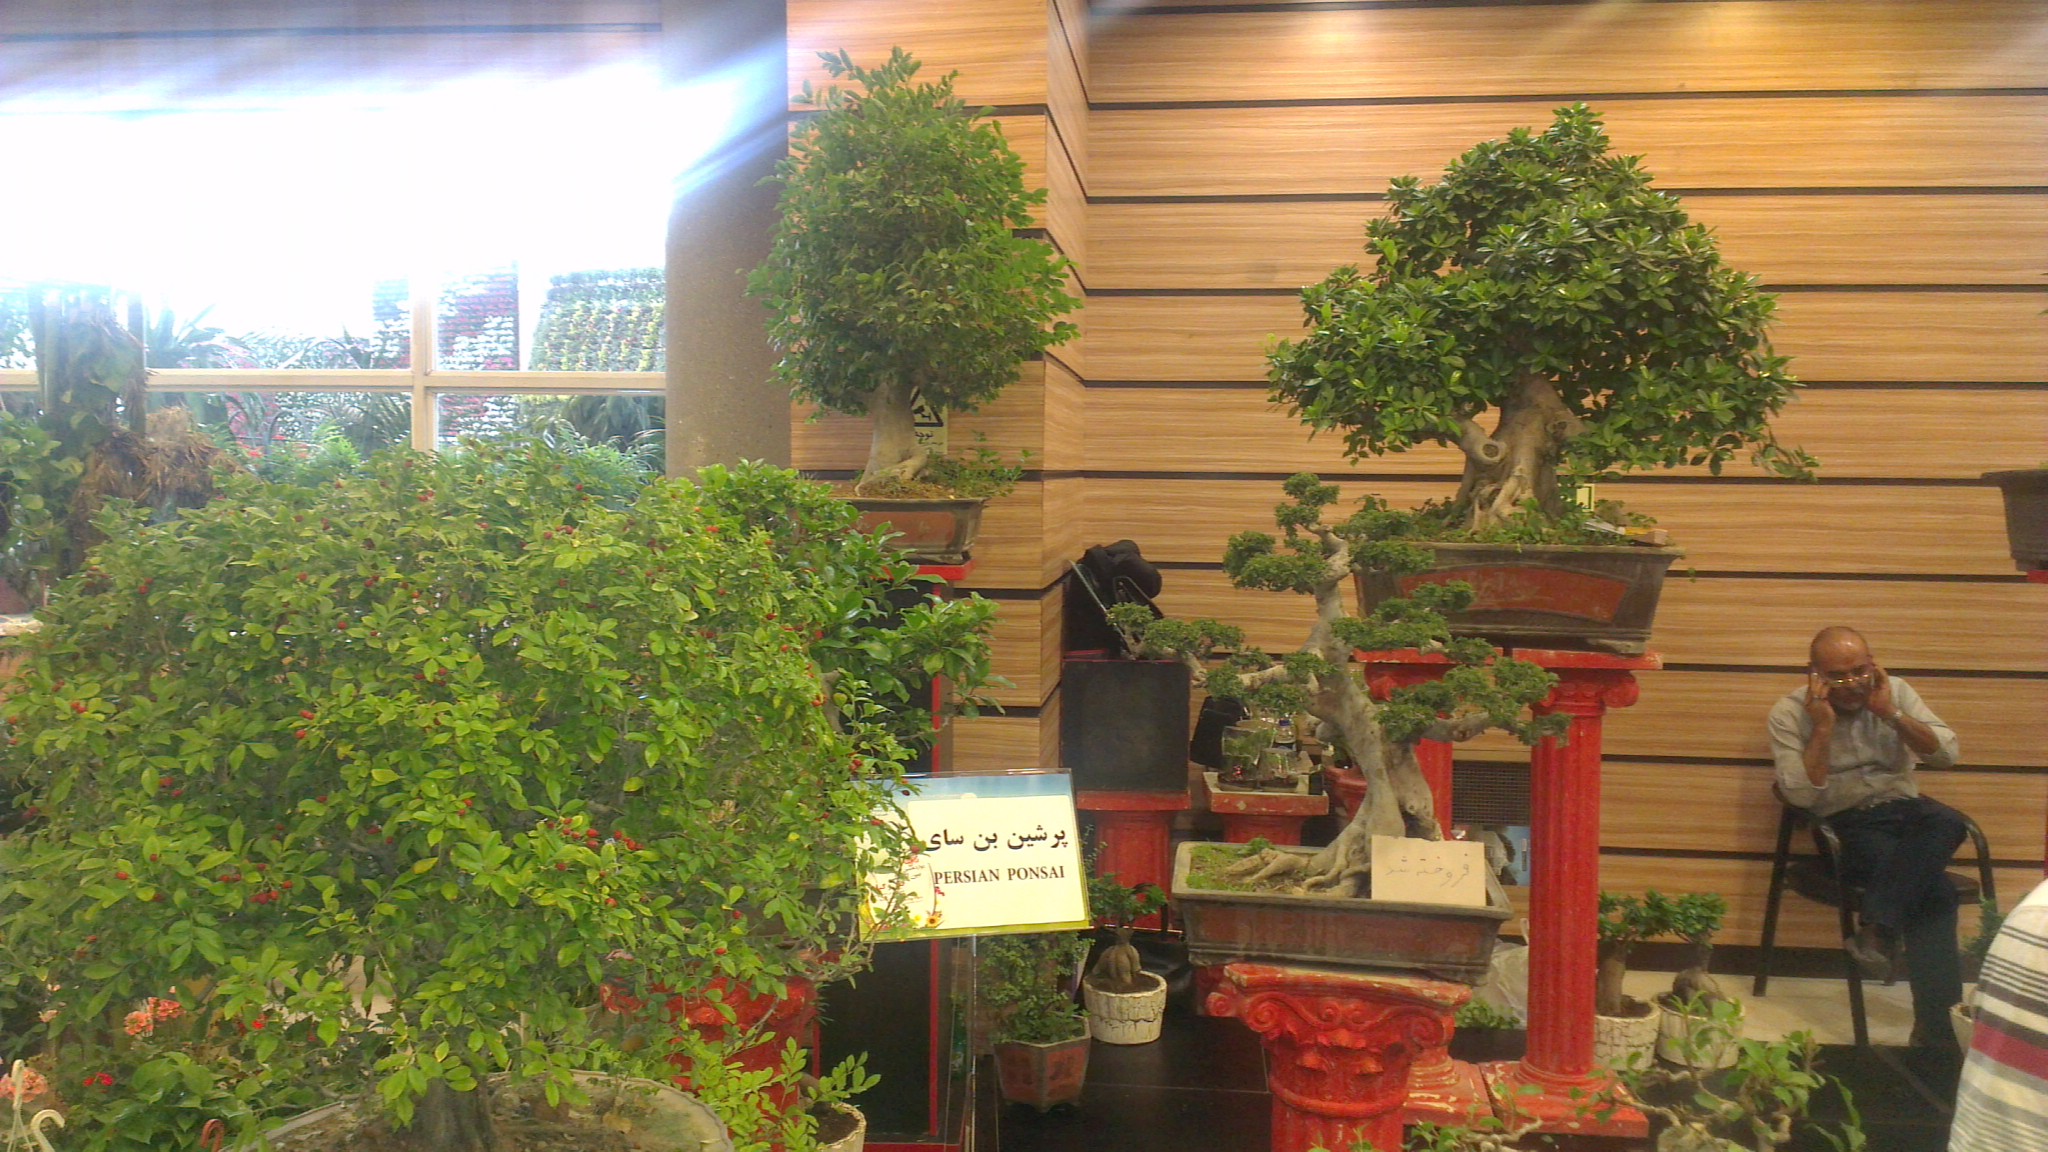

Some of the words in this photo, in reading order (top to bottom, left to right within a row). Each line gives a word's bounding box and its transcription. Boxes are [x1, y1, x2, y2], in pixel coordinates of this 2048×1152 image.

[925, 828, 964, 852] سای
[973, 832, 998, 852] بن
[1007, 824, 1068, 850] پرشین
[934, 868, 1000, 885] PERSIAN
[1007, 865, 1065, 881] PONSAI
[1416, 853, 1470, 888] فروخته
